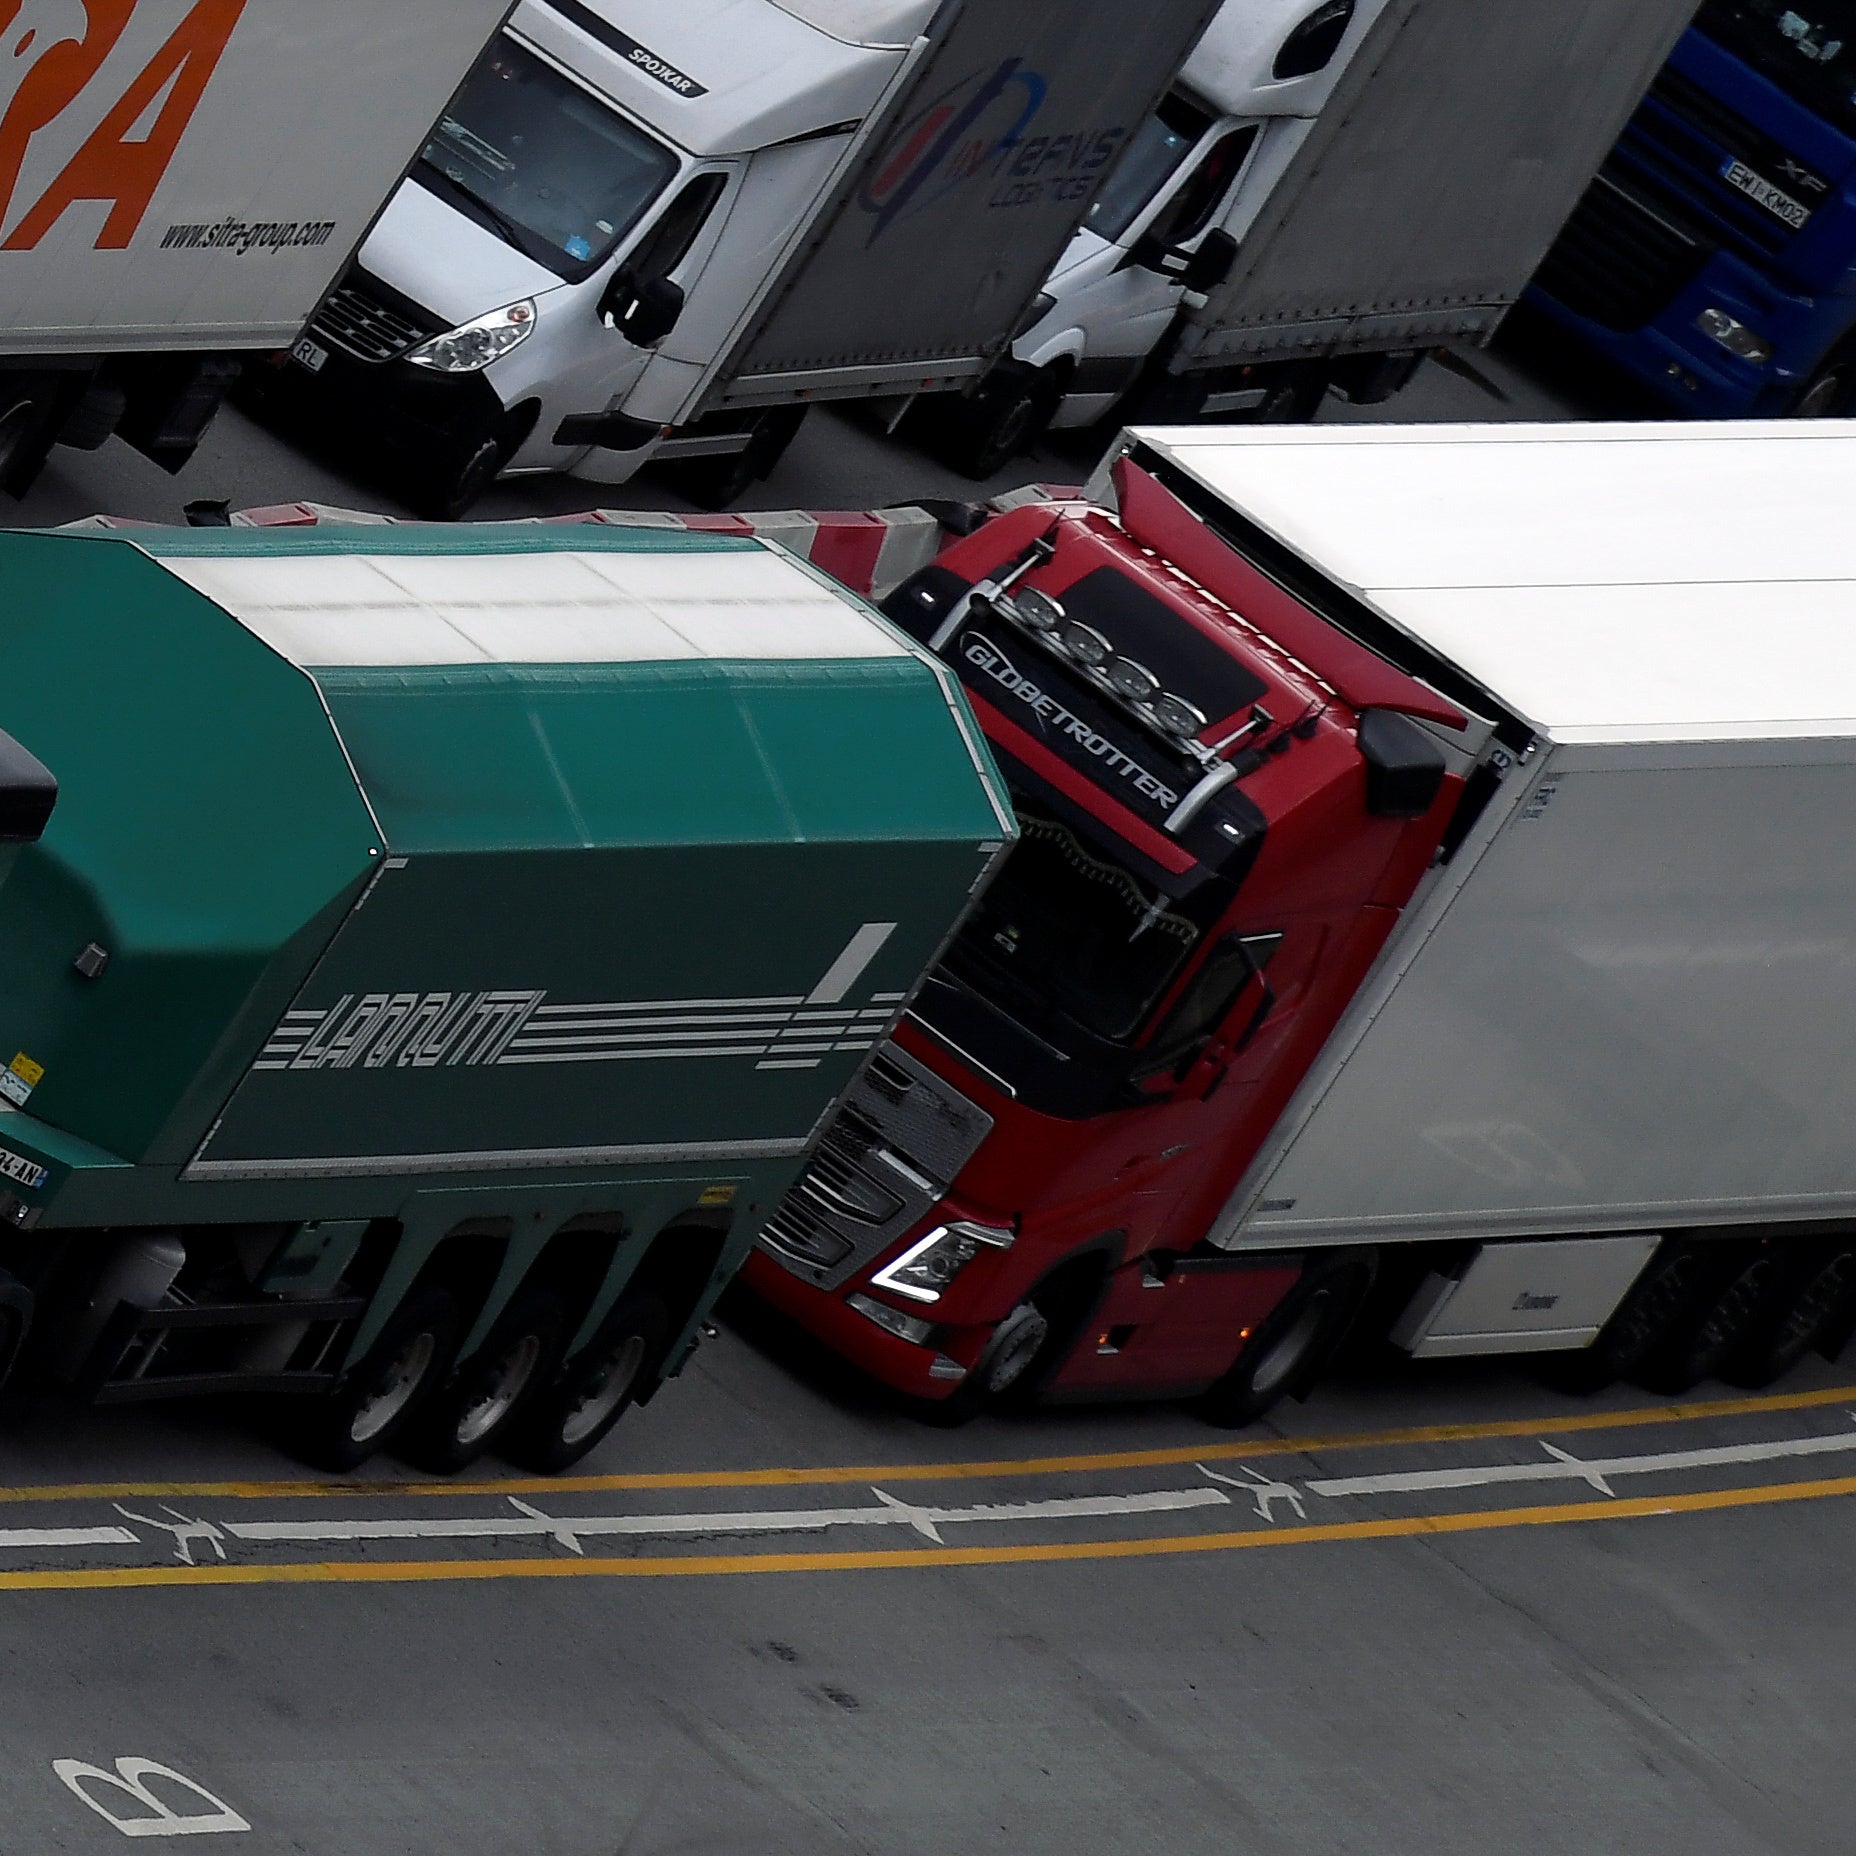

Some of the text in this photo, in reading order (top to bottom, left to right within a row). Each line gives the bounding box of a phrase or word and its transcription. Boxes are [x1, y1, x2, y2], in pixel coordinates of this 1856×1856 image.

[629, 47, 694, 92] SPOJKAR
[159, 215, 336, 256] www.sitra-group.com
[966, 643, 1179, 811] GLOBETROTTER
[51, 1755, 253, 1837] B
